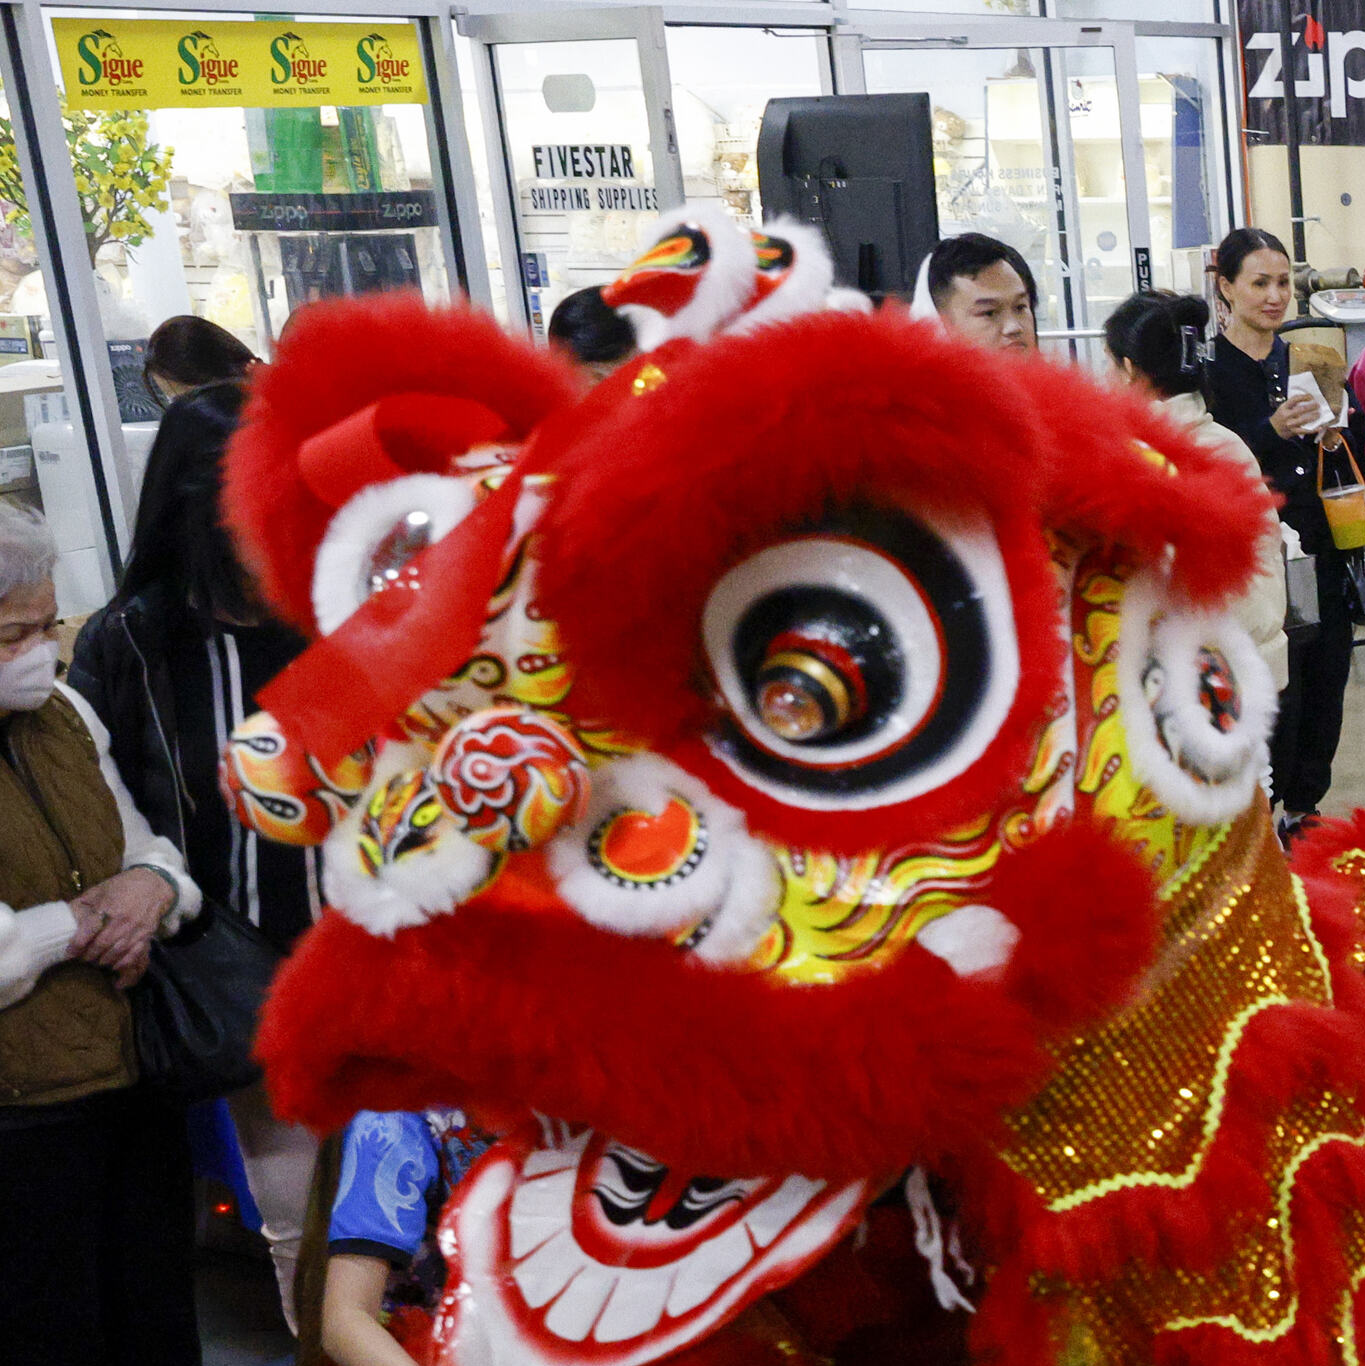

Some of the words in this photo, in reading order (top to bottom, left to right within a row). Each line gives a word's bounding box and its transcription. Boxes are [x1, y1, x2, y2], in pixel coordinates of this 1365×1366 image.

[78, 33, 144, 86] Sigue
[178, 35, 239, 86] Sigue
[270, 36, 327, 85] Sigue
[356, 37, 410, 84] Sigue
[81, 88, 108, 97] MONEY
[111, 88, 148, 97] TRANSFER
[180, 88, 206, 96] MONEY
[208, 88, 242, 96] TRANSFER
[273, 87, 296, 95] MONEY
[299, 87, 330, 95] TRANSFER
[359, 86, 381, 94] MONEY
[384, 86, 413, 94] TRANSFER
[532, 145, 634, 178] FIVESTAR
[531, 188, 590, 209] SHIPPING
[258, 203, 308, 224] zippo
[381, 203, 423, 221] zippo
